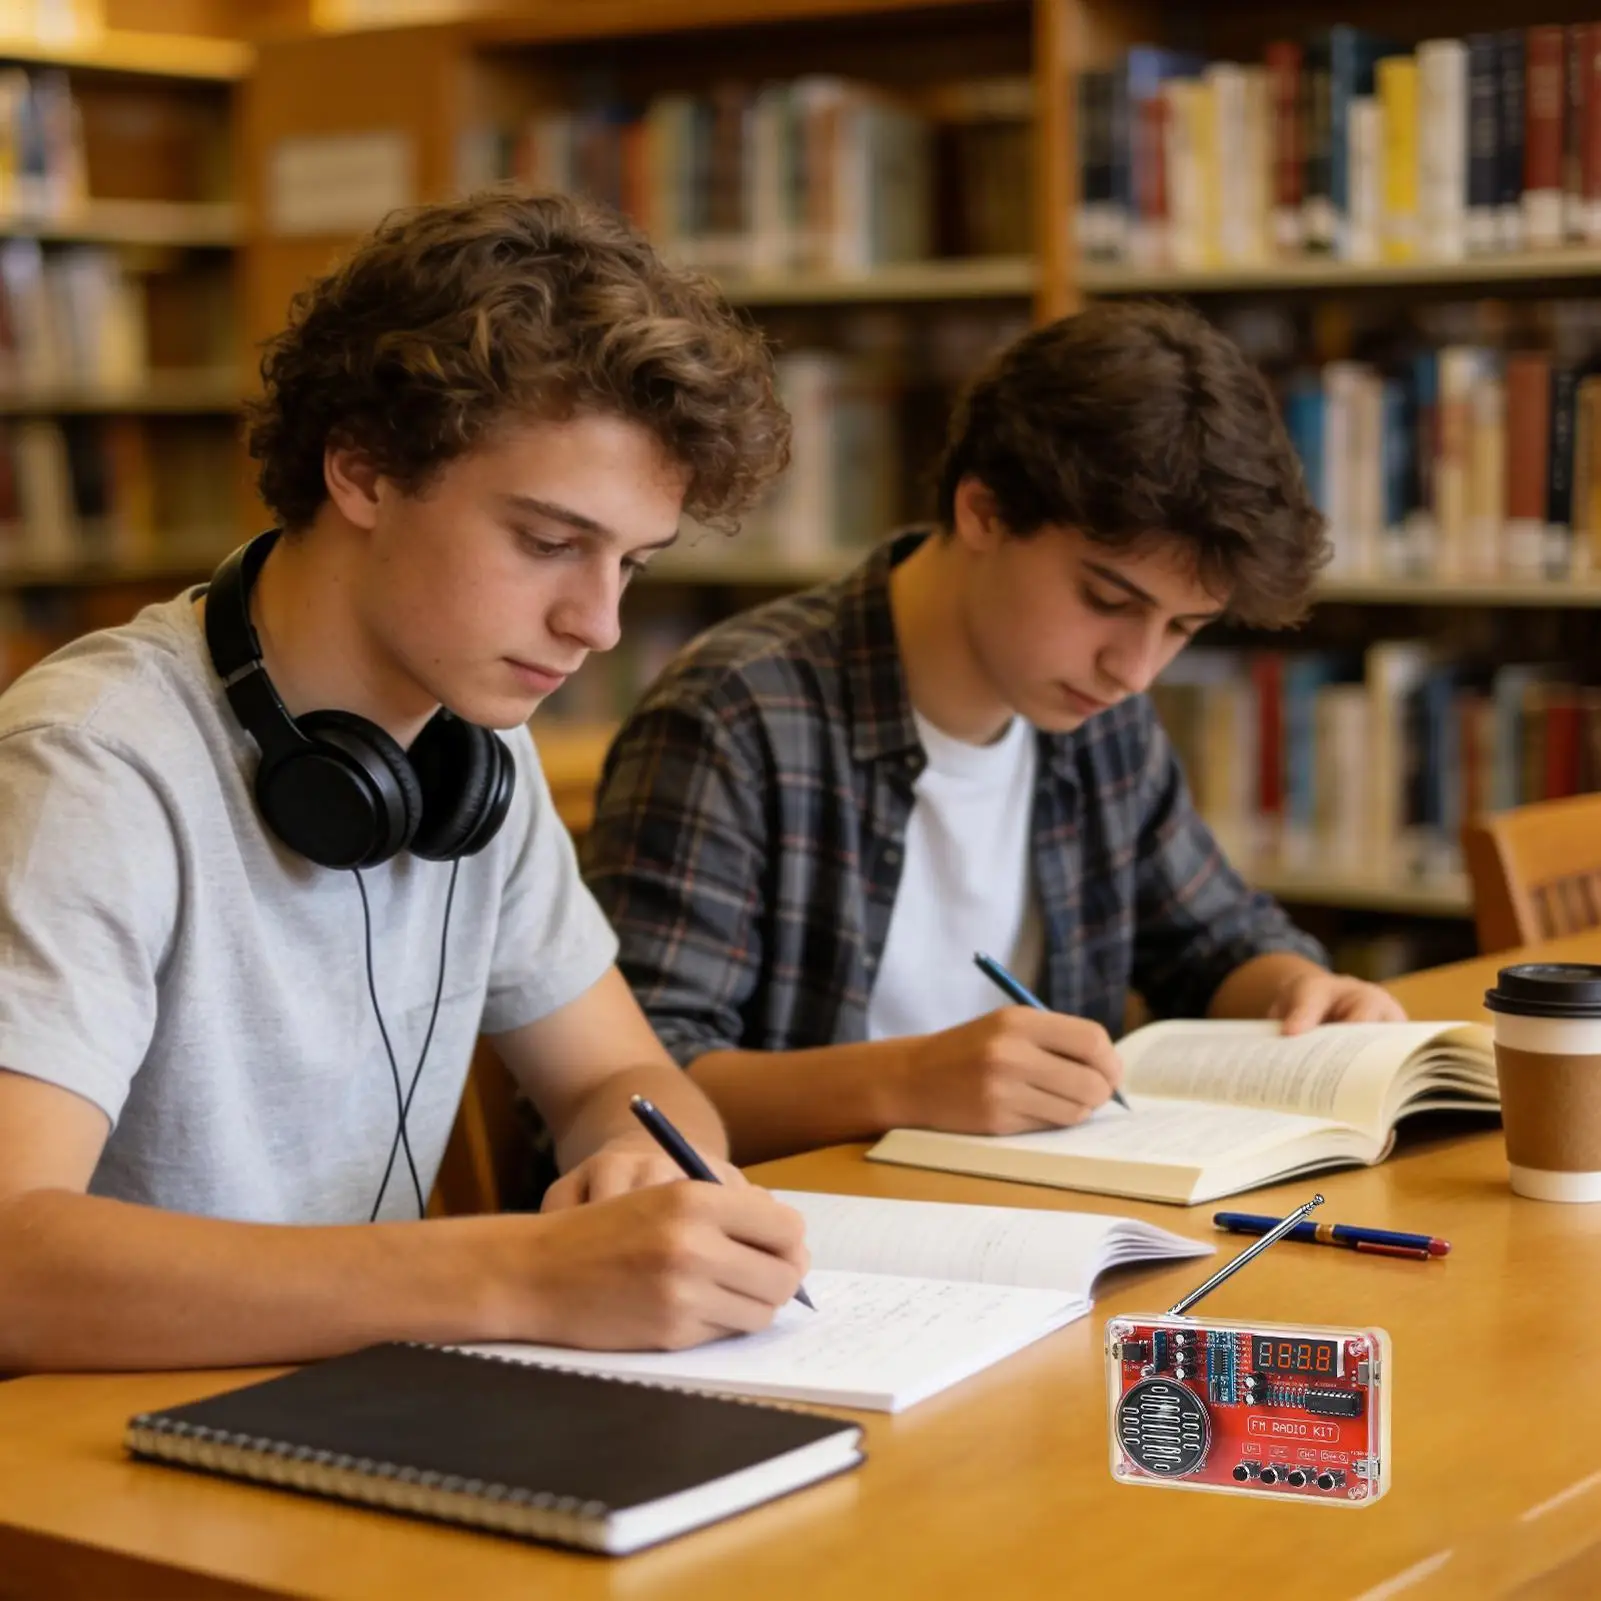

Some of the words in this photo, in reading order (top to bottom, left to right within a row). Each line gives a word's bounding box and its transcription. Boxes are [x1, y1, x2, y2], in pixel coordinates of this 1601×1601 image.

[1251, 1420, 1266, 1431] FM
[1272, 1421, 1307, 1435] RADIO
[1312, 1426, 1334, 1437] KIT
